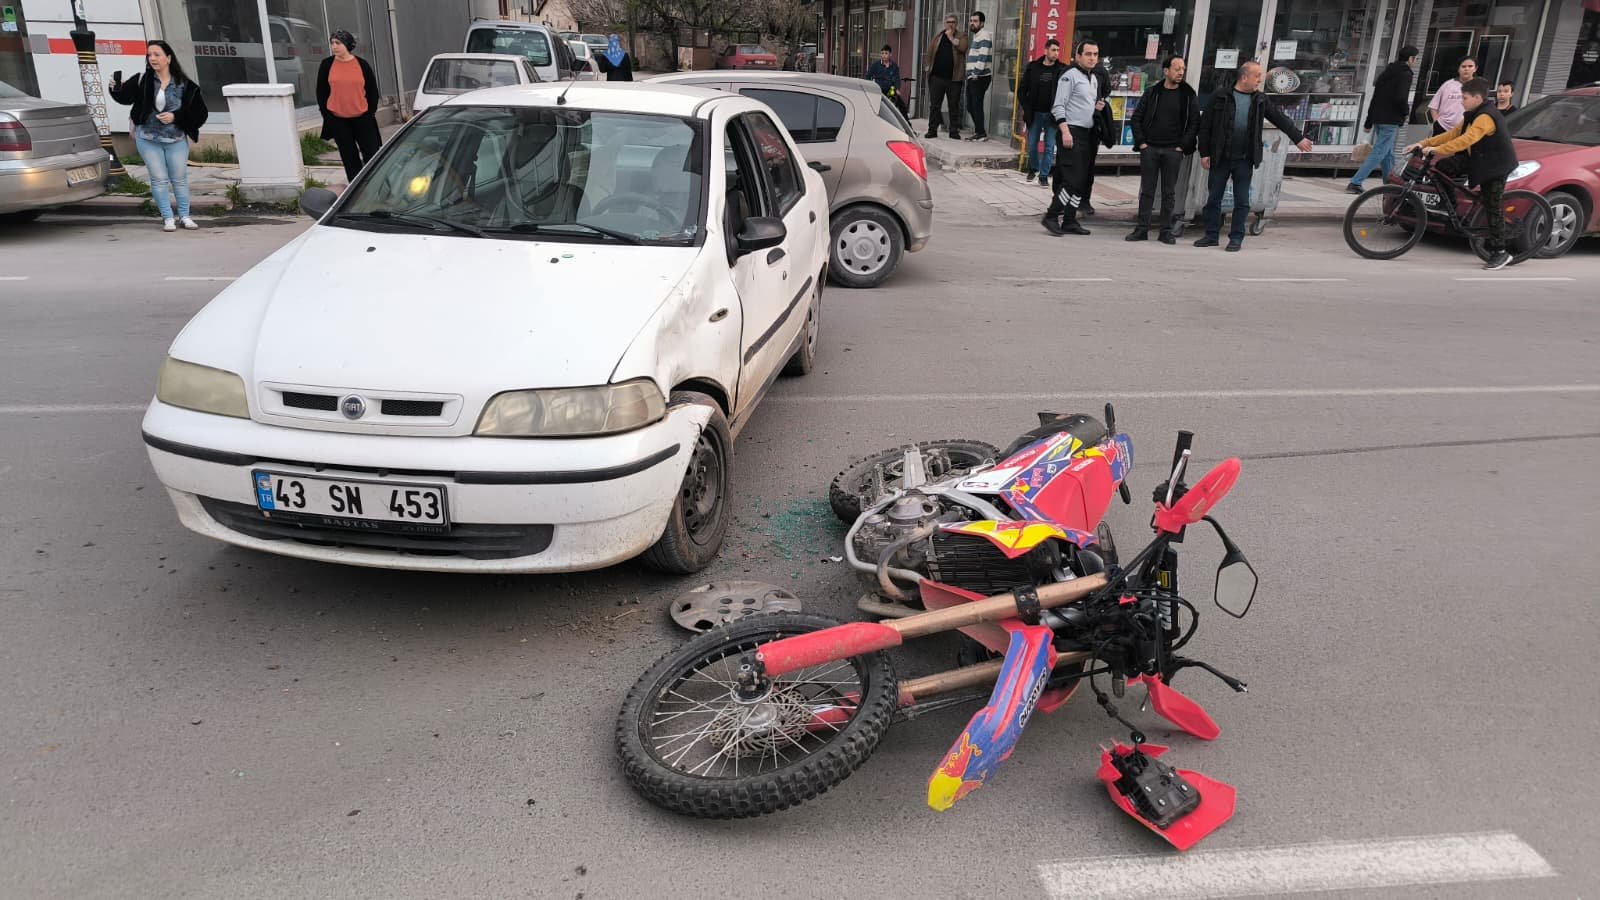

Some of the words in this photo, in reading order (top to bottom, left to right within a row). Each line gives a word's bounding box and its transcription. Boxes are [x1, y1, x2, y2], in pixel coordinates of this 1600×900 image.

[262, 494, 273, 503] TR
[276, 479, 306, 509] 43
[329, 484, 363, 515] SN
[390, 489, 440, 520] 453
